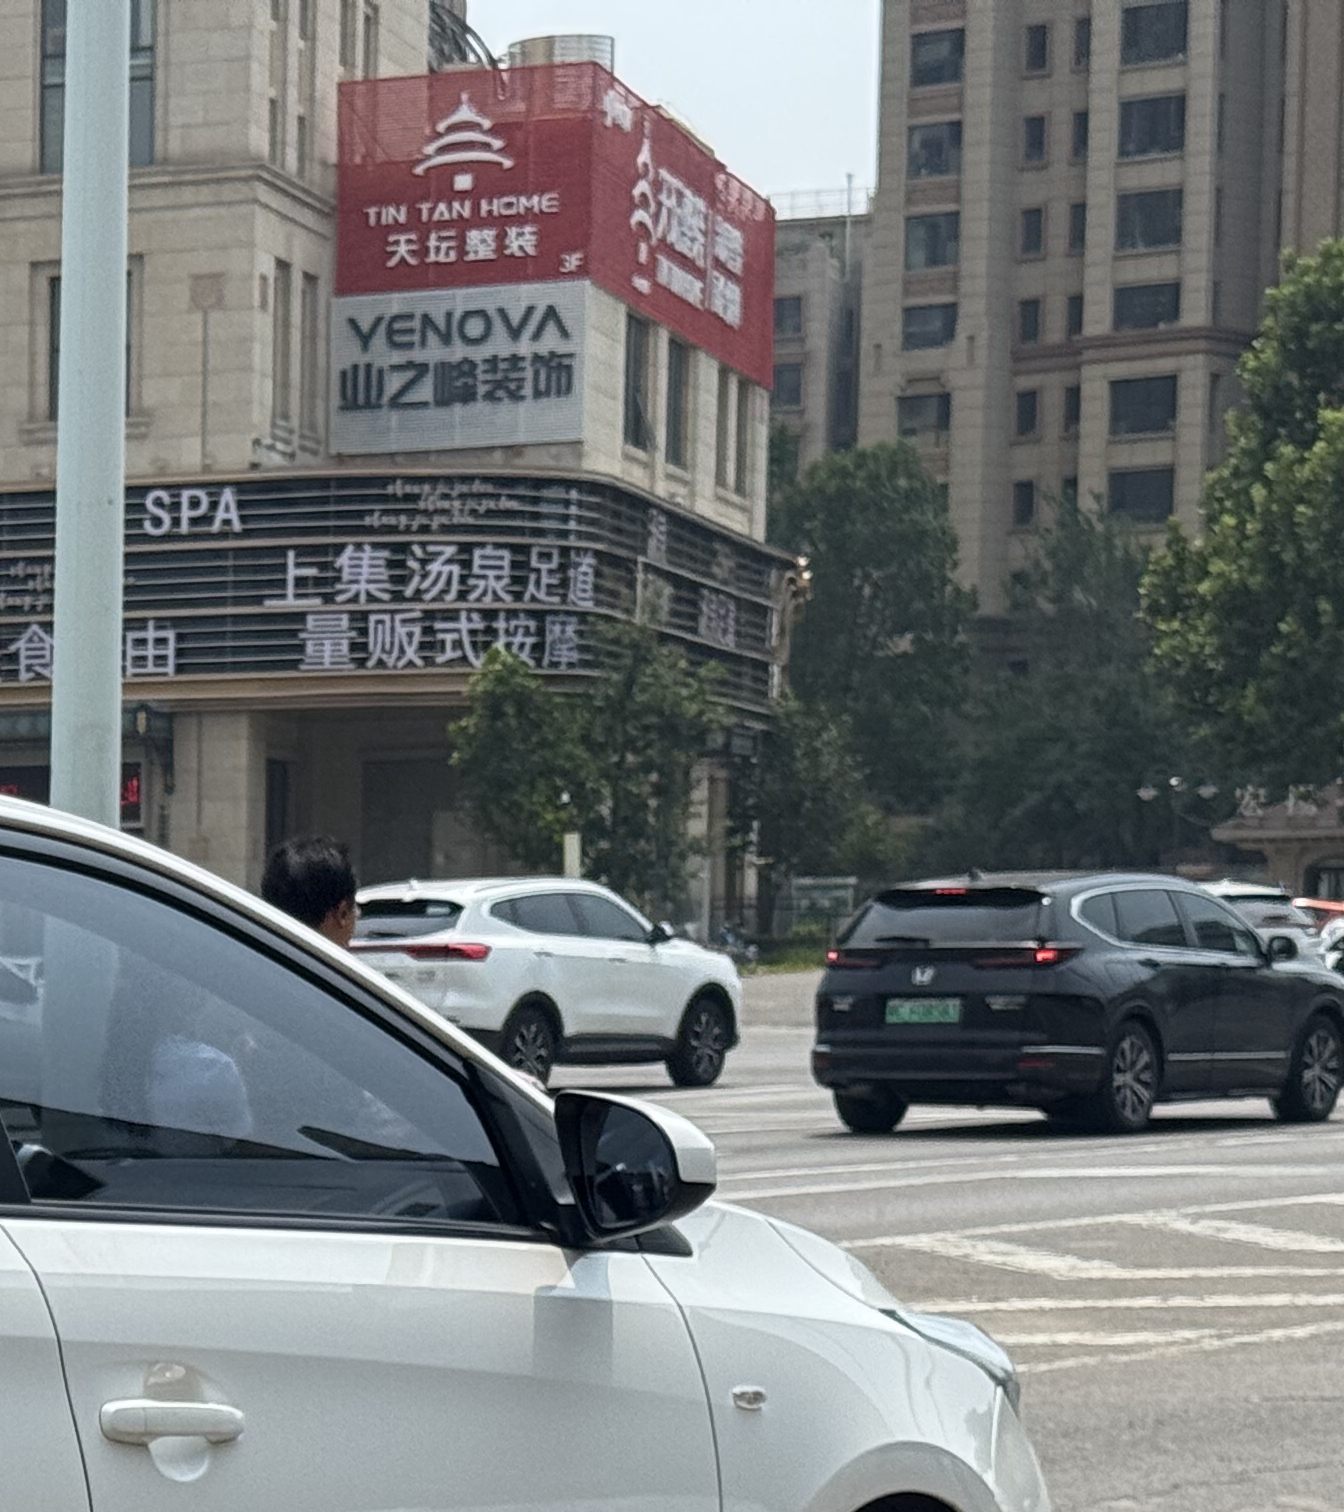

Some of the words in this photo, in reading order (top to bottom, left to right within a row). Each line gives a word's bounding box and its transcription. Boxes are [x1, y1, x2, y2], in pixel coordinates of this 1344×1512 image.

[363, 202, 408, 228] TIN
[415, 198, 473, 223] TAN
[479, 191, 561, 218] HOME
[384, 223, 539, 268] 天坛整装
[348, 304, 571, 351] YENOVA
[339, 350, 576, 411] 业之峰装饰
[143, 486, 243, 536] SPA
[263, 543, 599, 608] 上集汤泉足道
[298, 610, 580, 671] 量贩式按摩
